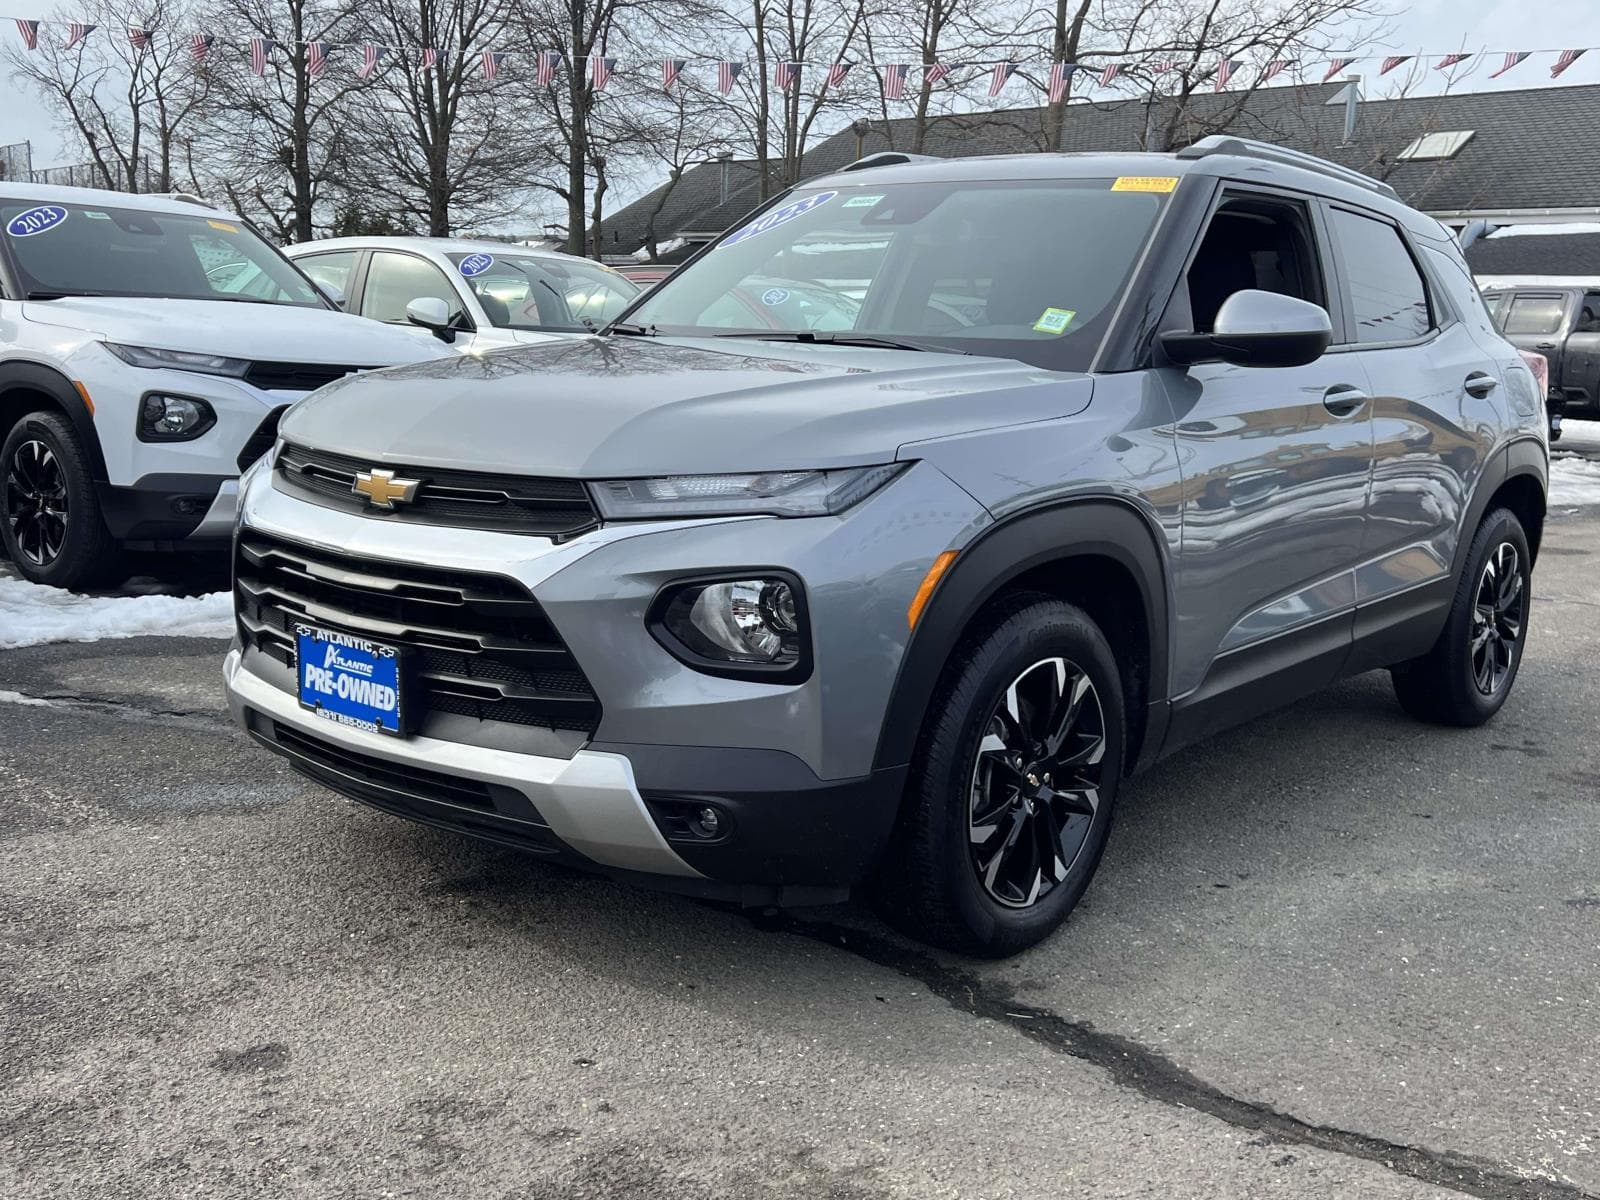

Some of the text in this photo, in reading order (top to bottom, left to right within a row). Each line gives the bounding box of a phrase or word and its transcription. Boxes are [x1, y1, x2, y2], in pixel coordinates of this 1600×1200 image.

[17, 207, 57, 233] 2023
[736, 197, 819, 241] 2023
[464, 255, 488, 273] 2023
[316, 630, 372, 653] ATLANTIC
[305, 663, 396, 711] PRE-OWNED
